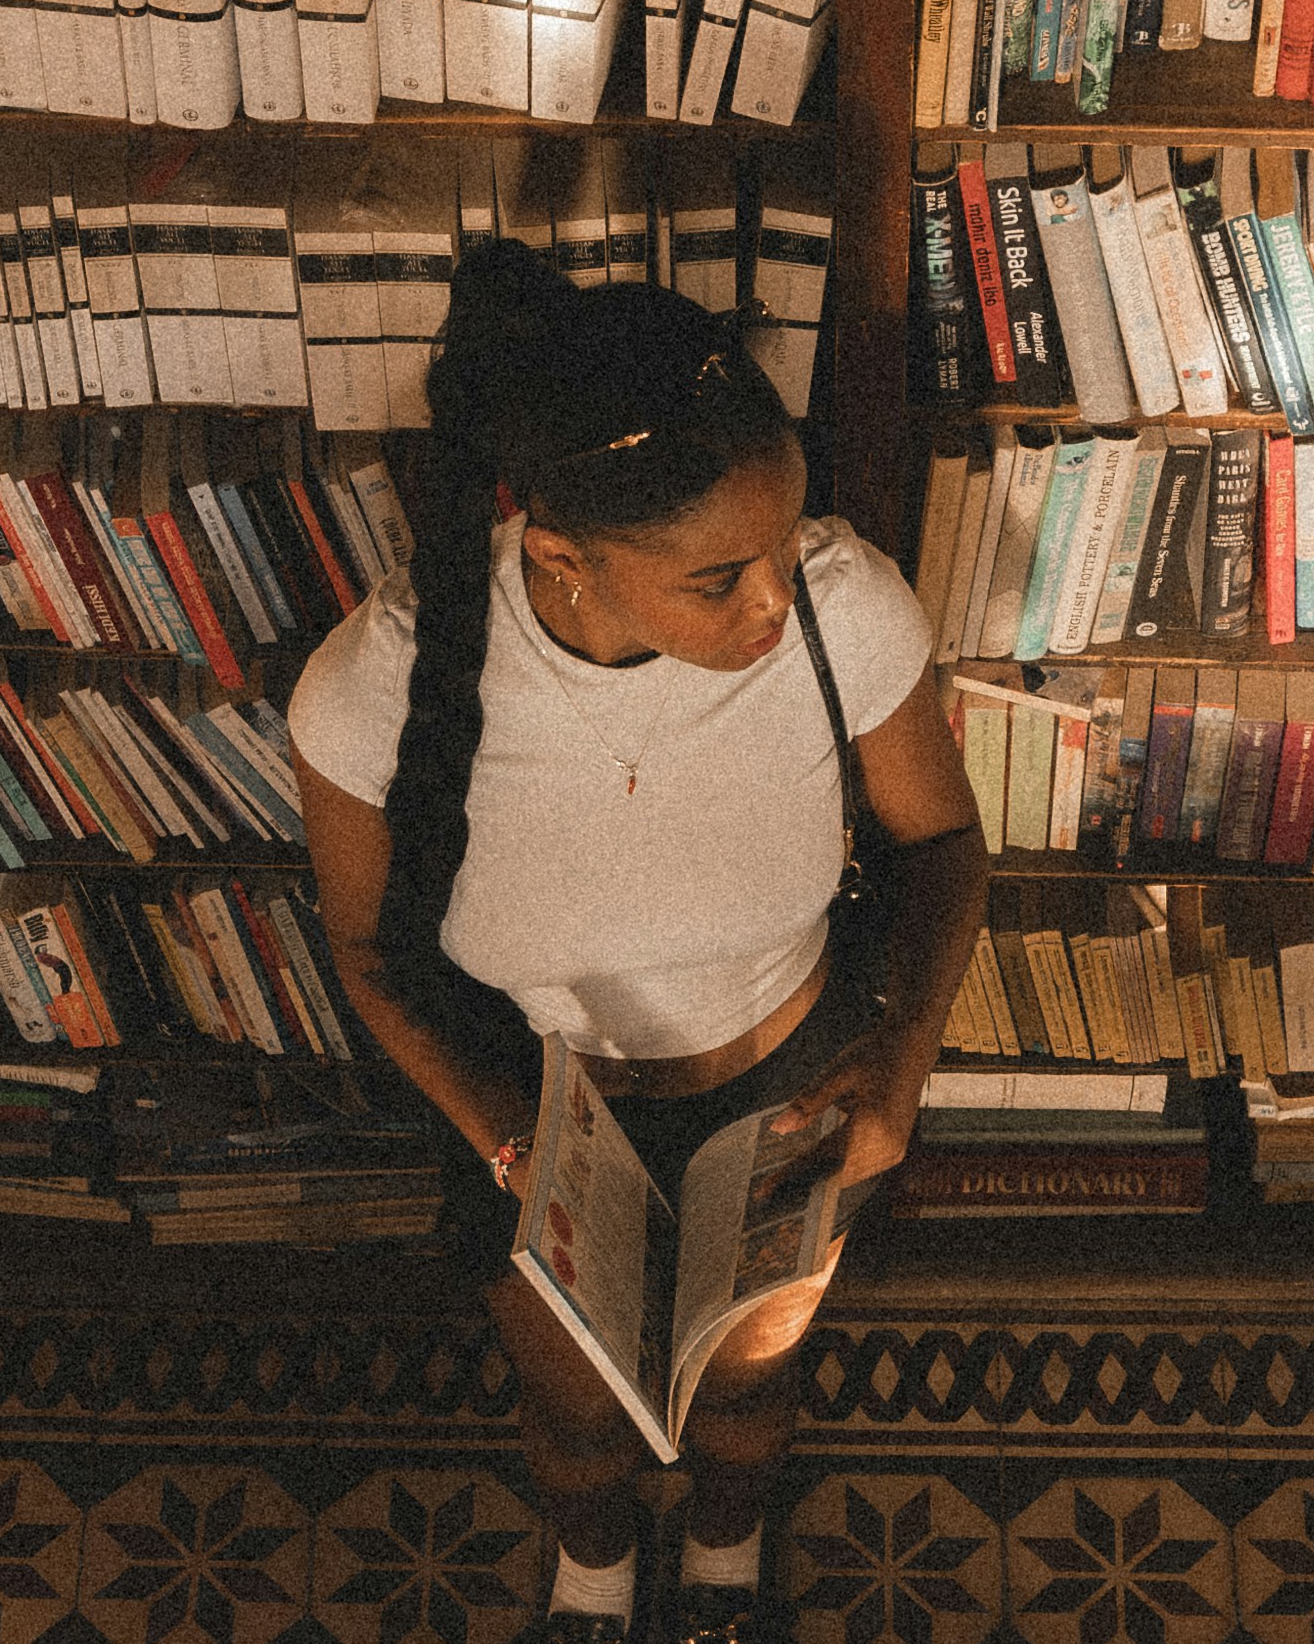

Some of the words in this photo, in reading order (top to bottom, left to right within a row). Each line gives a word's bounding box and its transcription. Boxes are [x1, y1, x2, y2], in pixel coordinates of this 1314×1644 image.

[996, 174, 1029, 217] Skin
[1003, 233, 1037, 282] Back
[1012, 310, 1035, 347] Lowell
[1027, 299, 1055, 357] Alexander
[959, 1172, 1147, 1196] DICTIONARY
